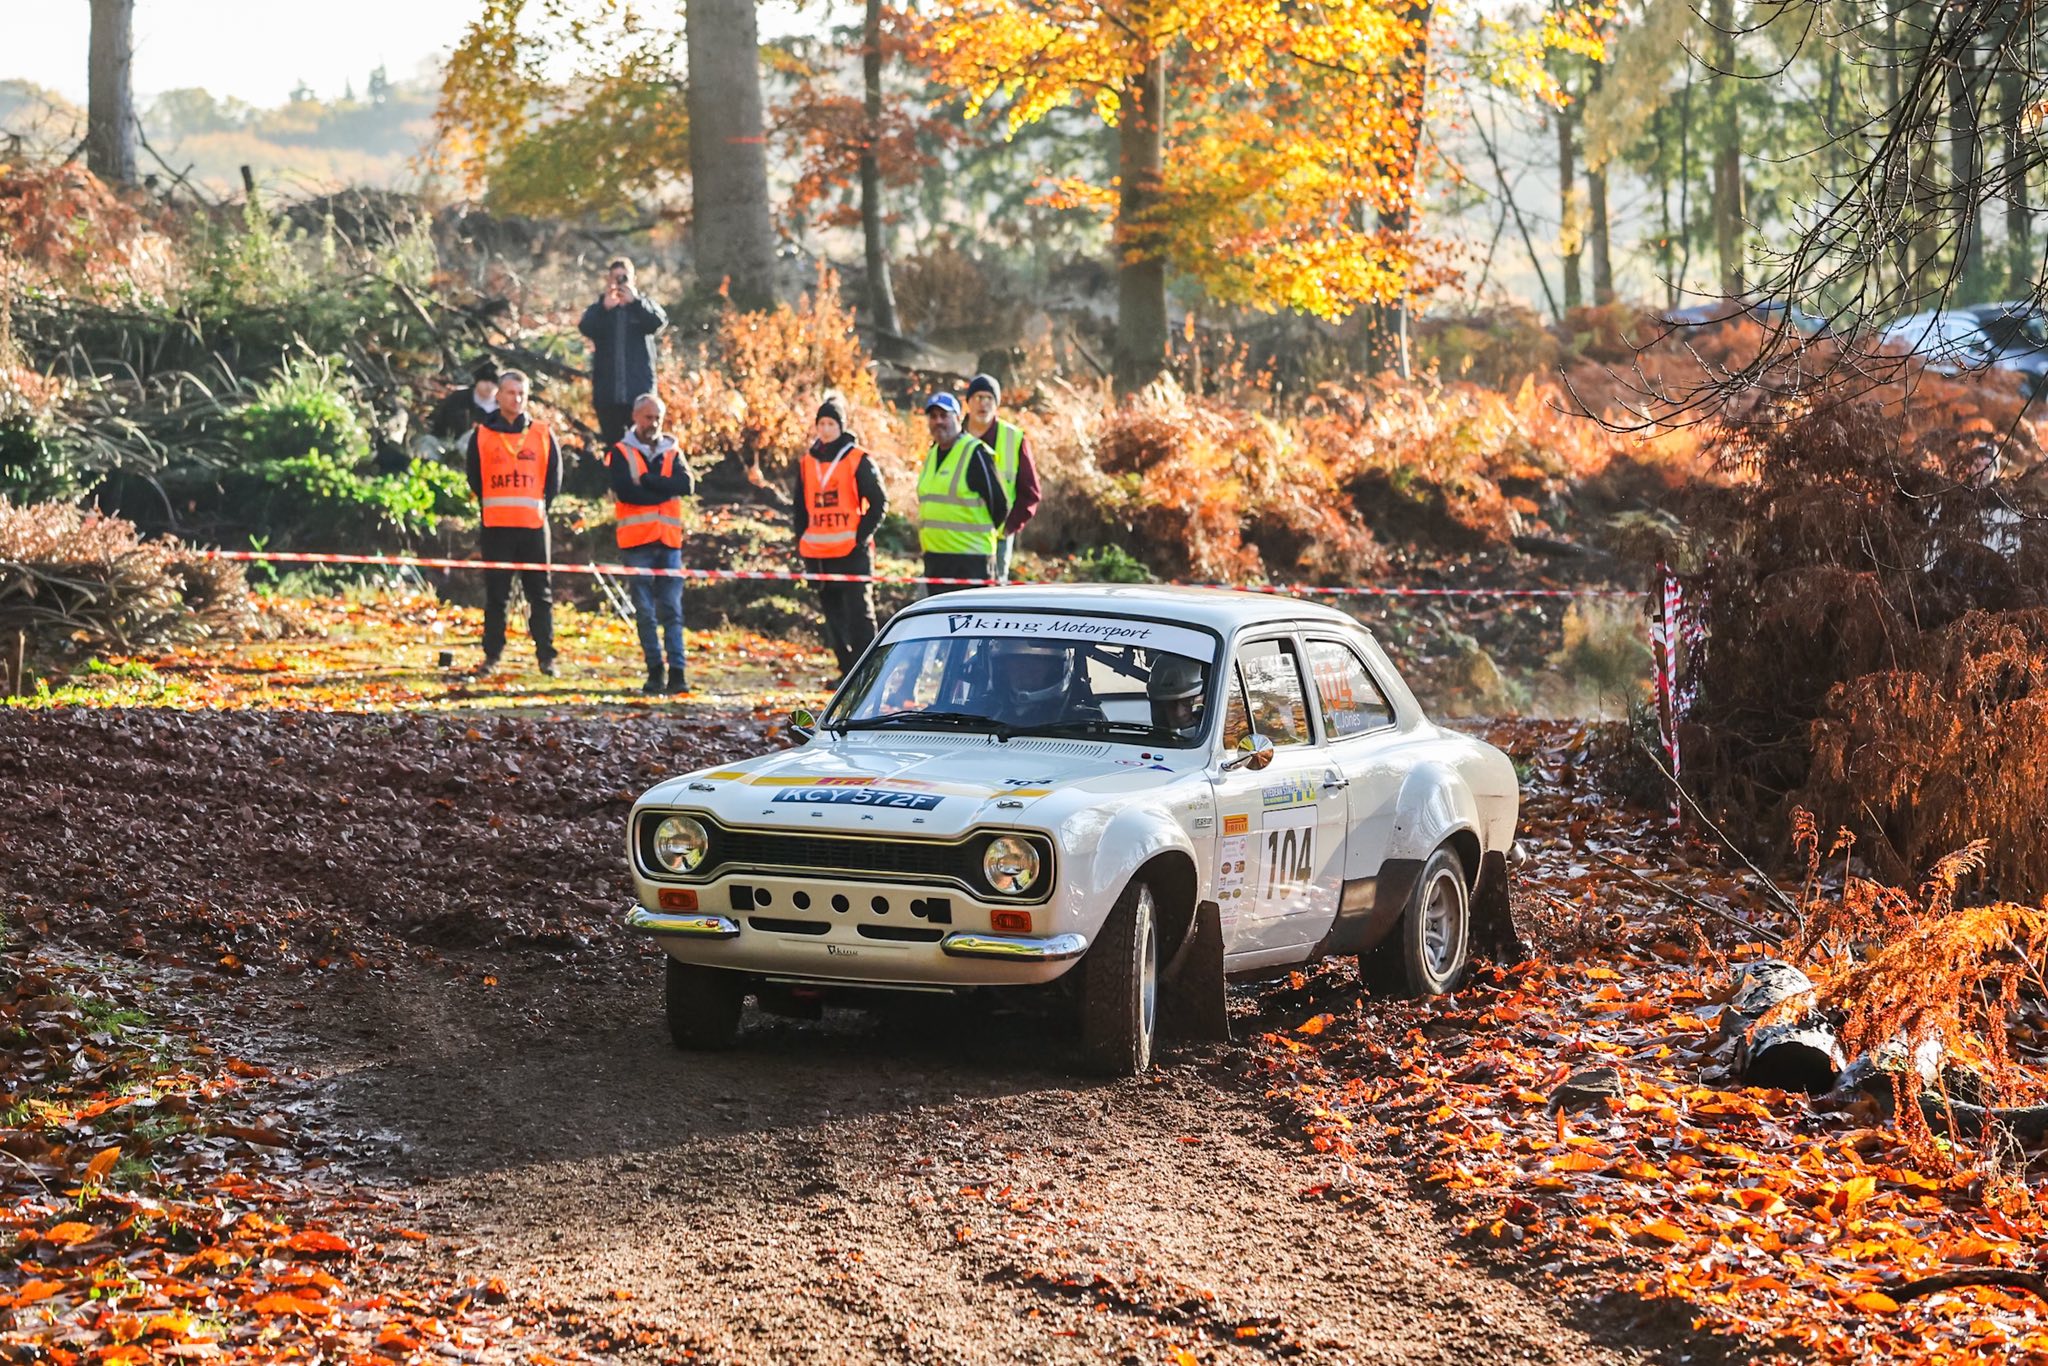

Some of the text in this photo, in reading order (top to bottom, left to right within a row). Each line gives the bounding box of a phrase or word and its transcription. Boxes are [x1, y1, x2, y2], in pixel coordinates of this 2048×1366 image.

[490, 473, 536, 489] SAFETY
[813, 512, 850, 528] AFETY
[947, 614, 1152, 641] Viking Motorsport
[1314, 660, 1356, 712] 104
[782, 788, 934, 808] KCY 572F
[1224, 817, 1248, 833] PIRELLI
[1266, 826, 1312, 900] 104
